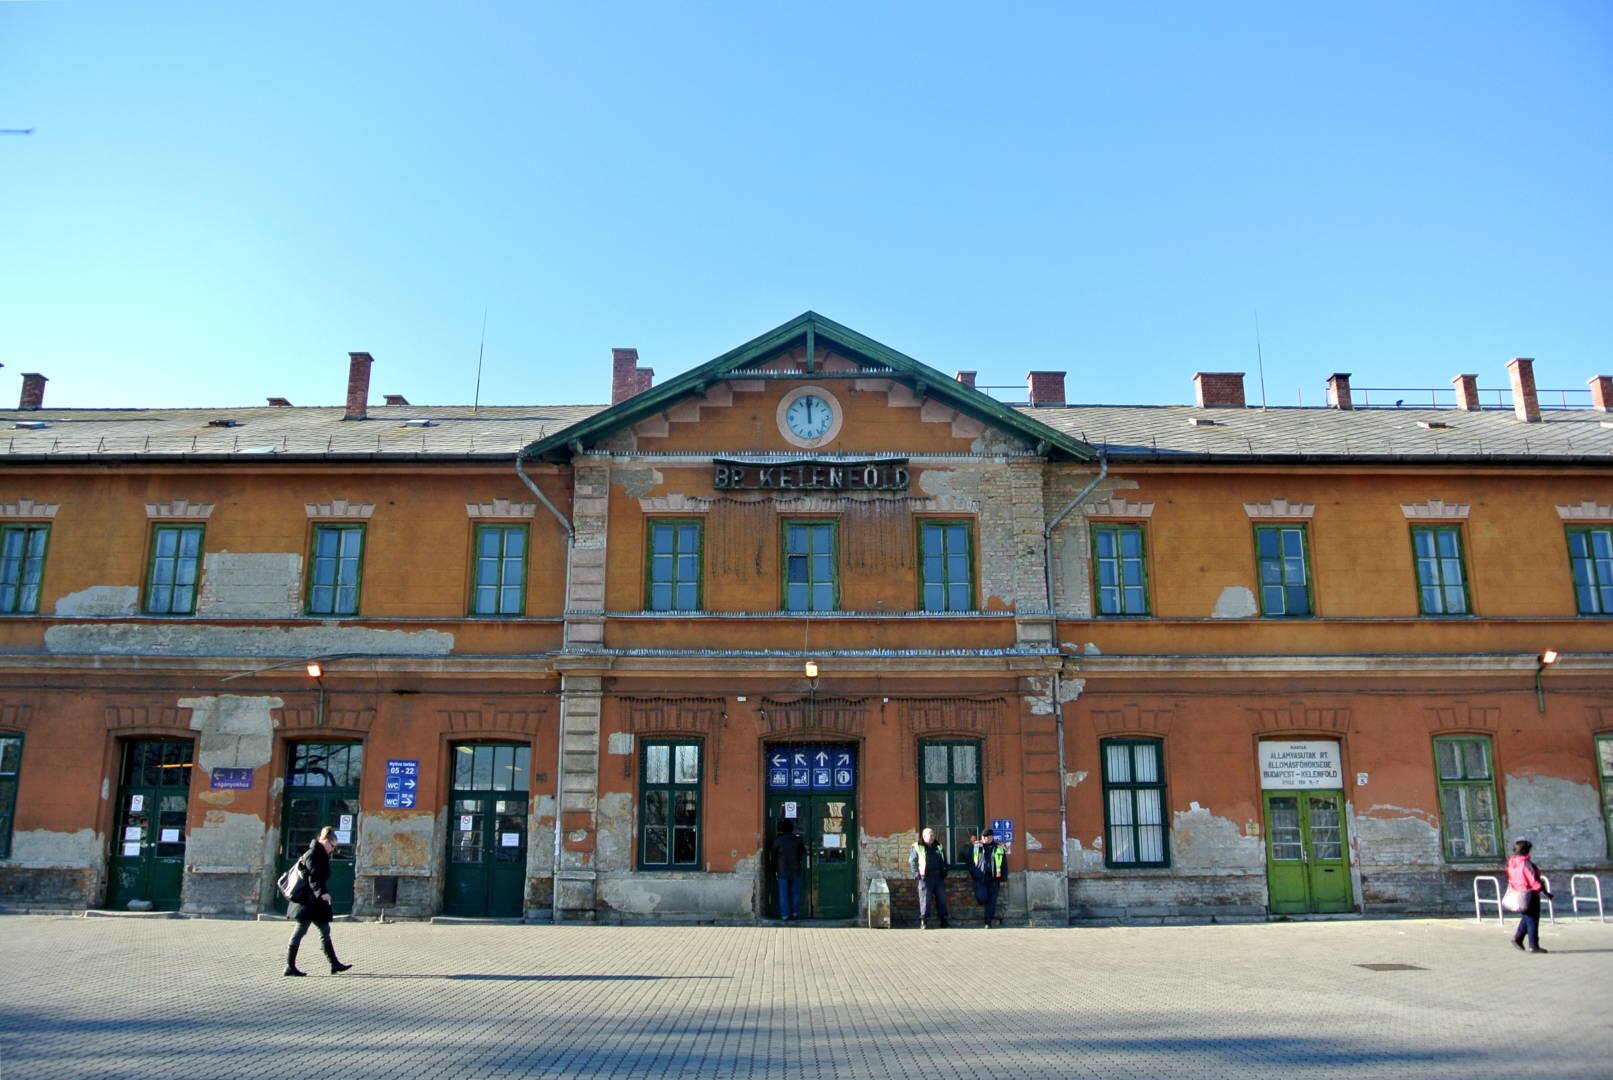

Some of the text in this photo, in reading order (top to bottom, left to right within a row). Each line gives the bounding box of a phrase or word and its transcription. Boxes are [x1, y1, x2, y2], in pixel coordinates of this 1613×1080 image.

[715, 464, 910, 488] BP KELENFÖLD
[240, 772, 248, 780] 2
